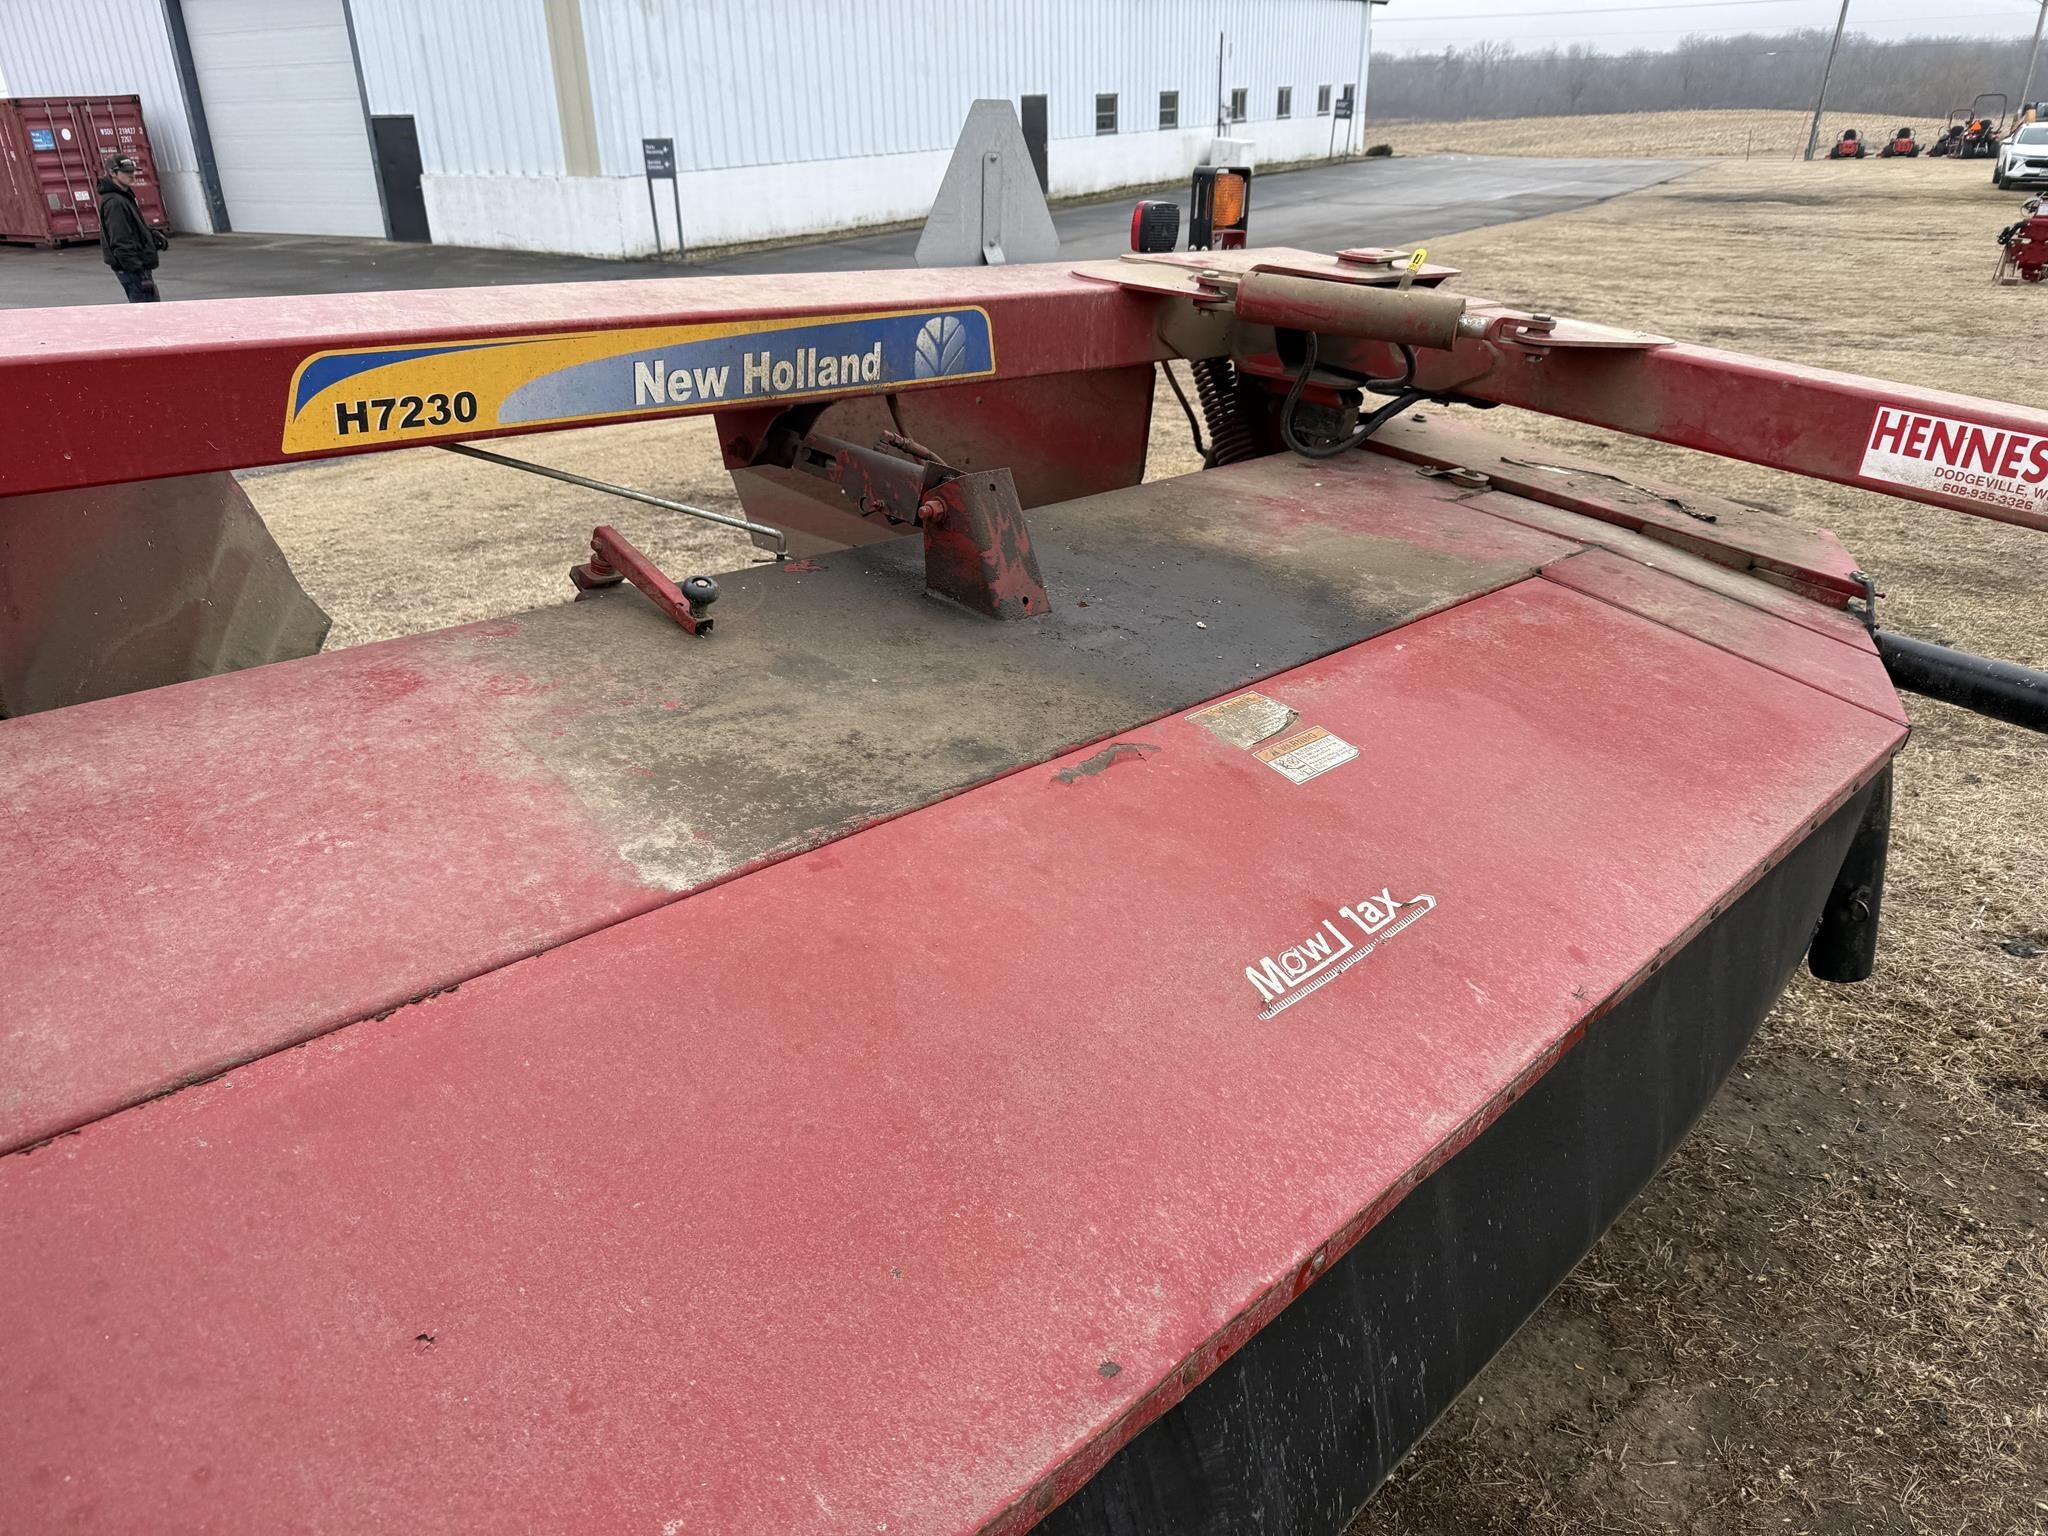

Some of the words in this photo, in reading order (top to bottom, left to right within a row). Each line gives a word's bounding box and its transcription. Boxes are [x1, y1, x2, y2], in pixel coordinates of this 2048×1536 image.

[633, 360, 729, 406] New
[742, 342, 882, 396] Holland
[336, 391, 479, 435] H7230
[1871, 410, 2048, 484] HENNES
[1934, 466, 2028, 498] DODGEVILLE,
[2034, 487, 2048, 501] W
[1942, 482, 2034, 511] 608-935-3326
